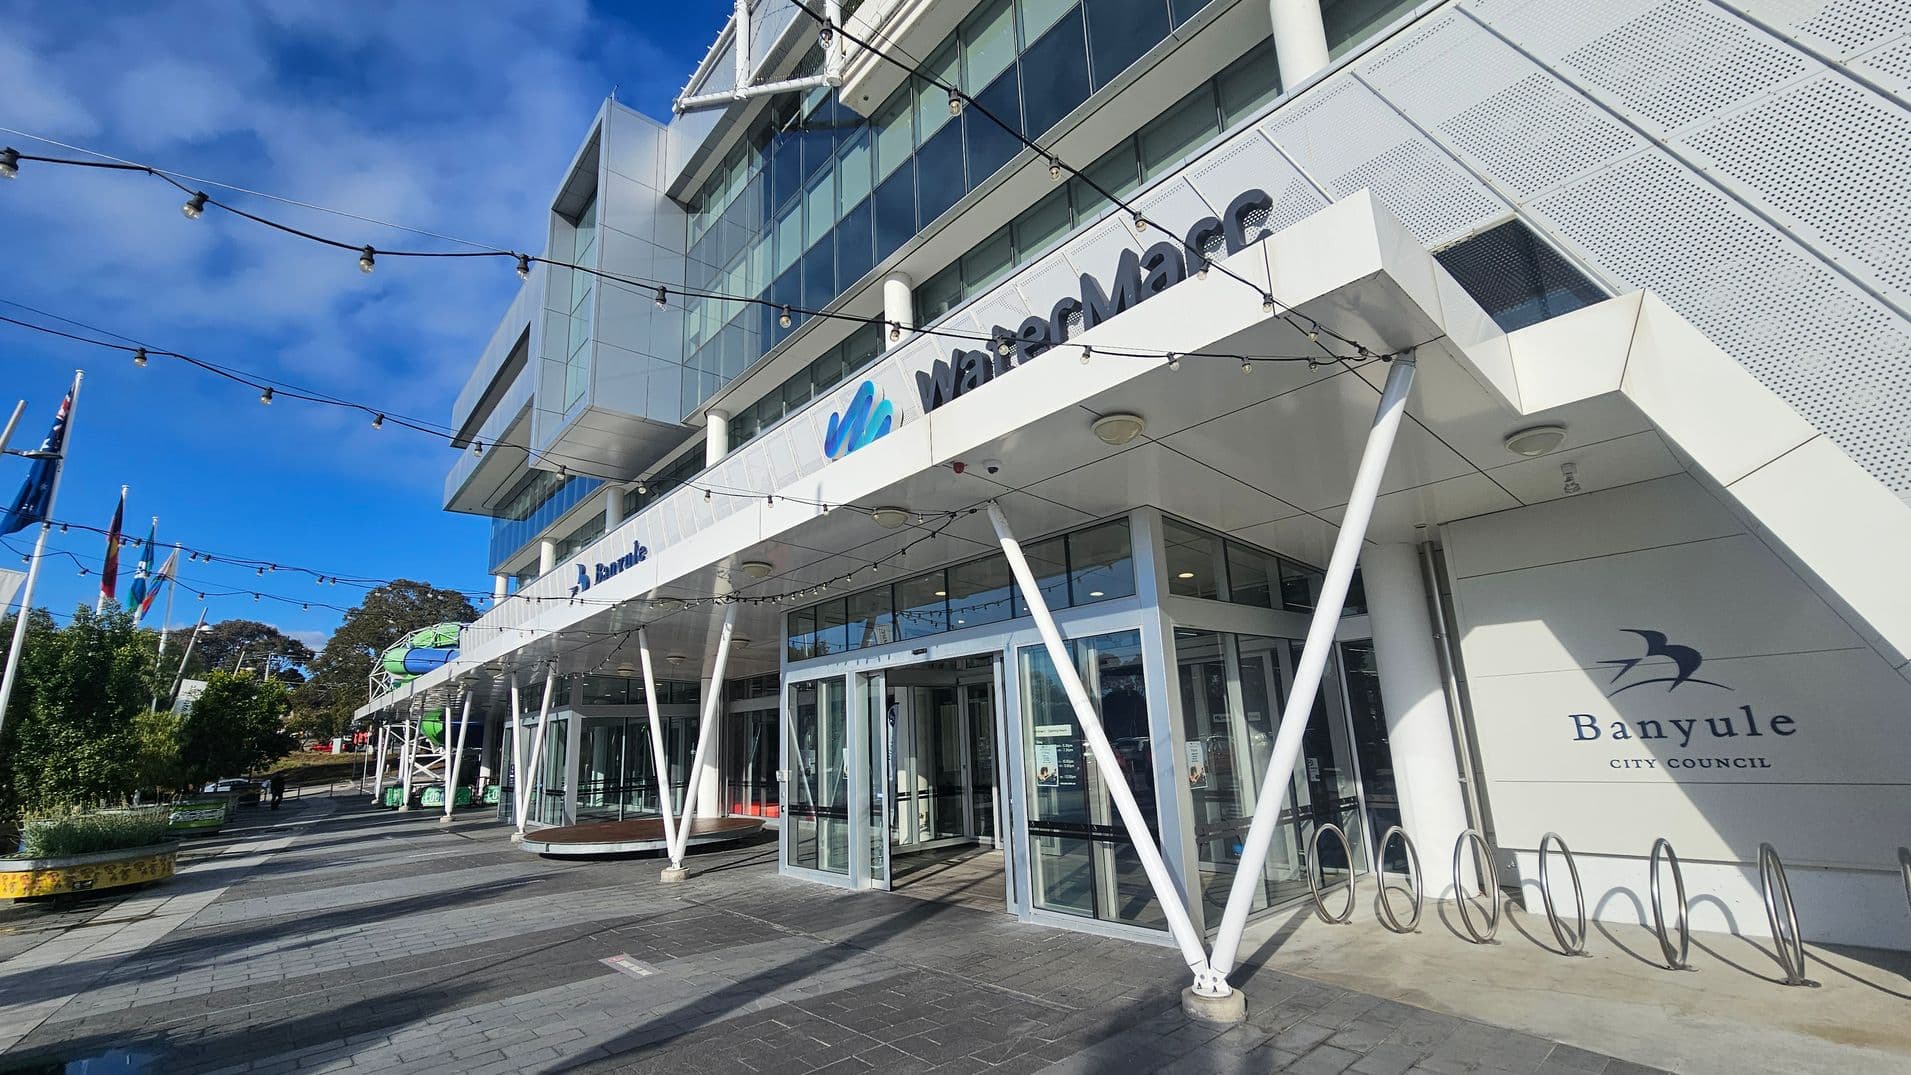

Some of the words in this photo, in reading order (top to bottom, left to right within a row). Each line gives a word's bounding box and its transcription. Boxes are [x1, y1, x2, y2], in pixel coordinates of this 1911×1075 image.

[915, 188, 1274, 414] WaterMarc
[594, 540, 649, 586] Banyule
[1568, 704, 1797, 748] Banyule
[1609, 758, 1657, 769] CITY
[1667, 757, 1772, 769] COUNCIL
